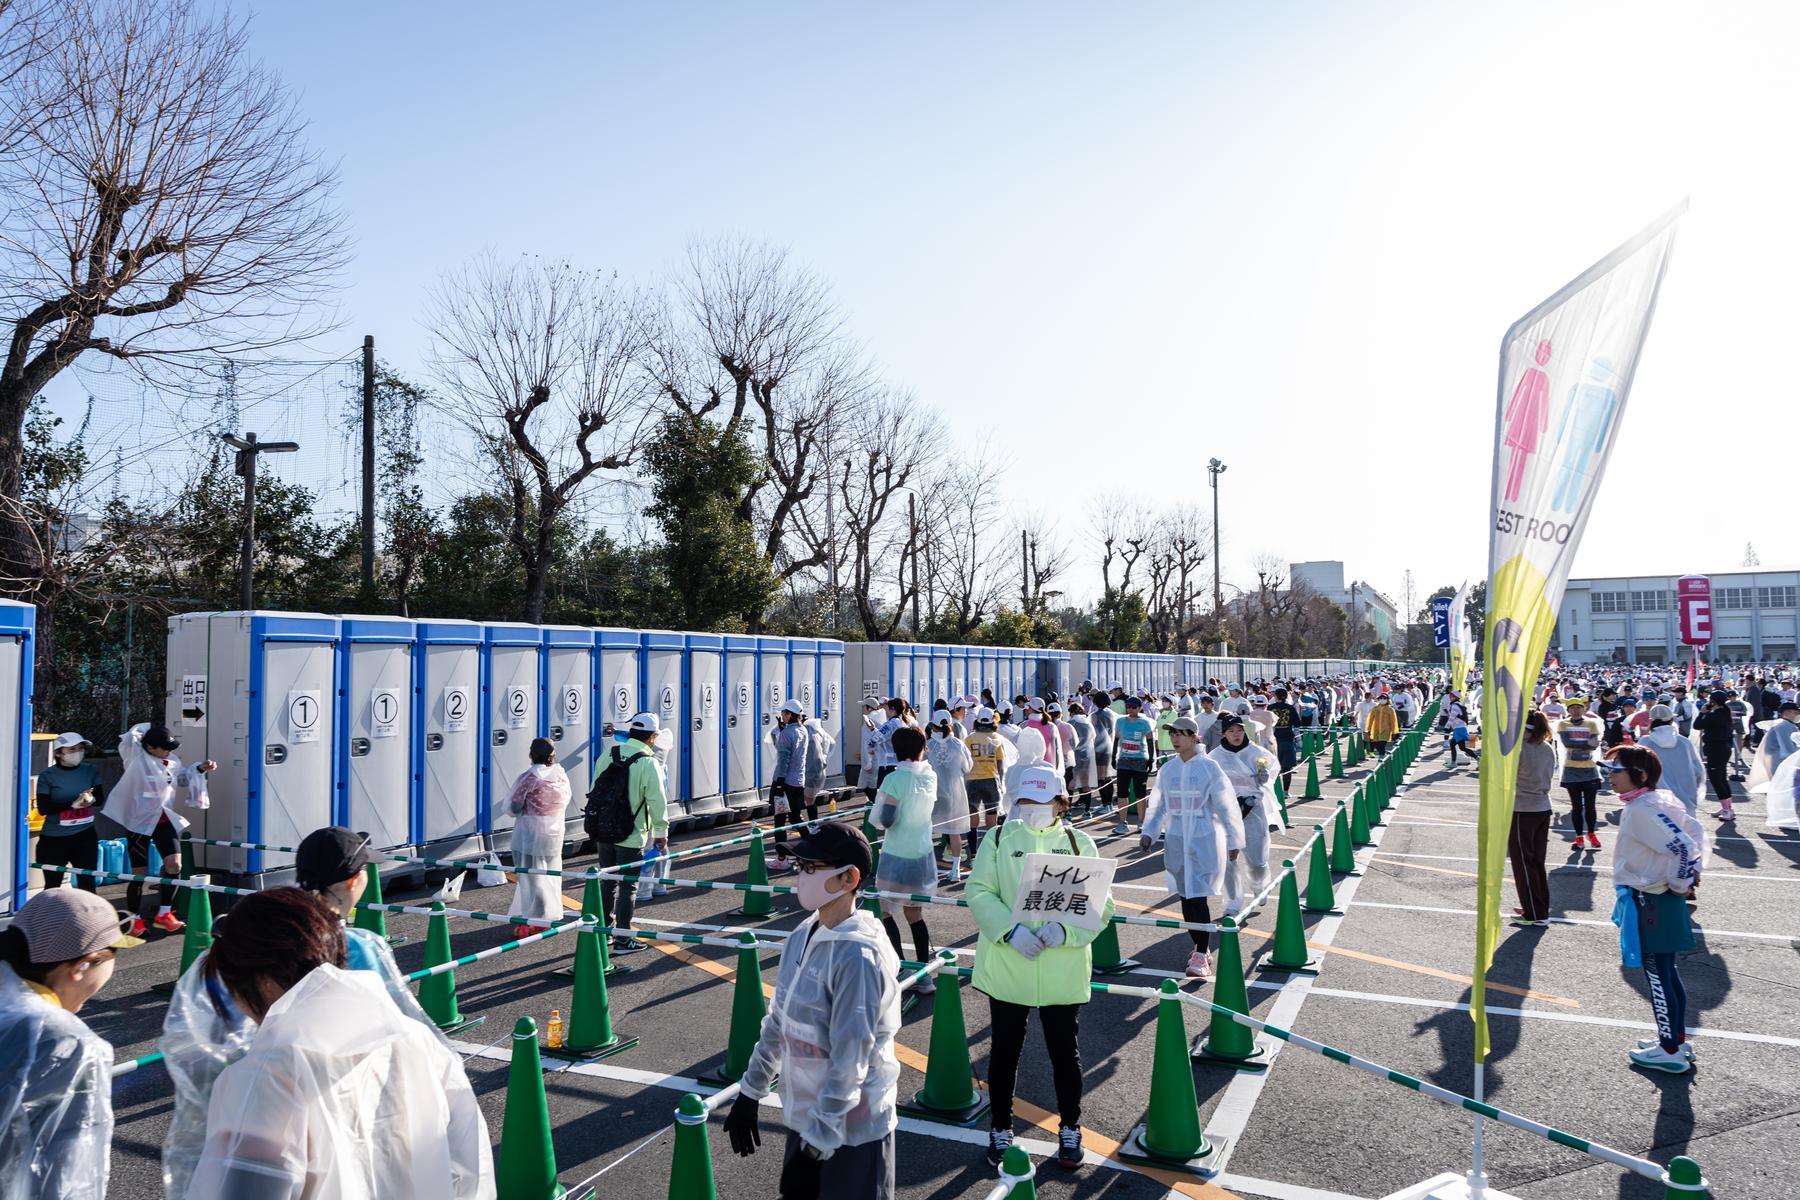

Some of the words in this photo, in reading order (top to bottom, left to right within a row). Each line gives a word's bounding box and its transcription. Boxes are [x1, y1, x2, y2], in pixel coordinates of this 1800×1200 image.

[1496, 508, 1524, 536] EST
[1525, 517, 1571, 545] ROO
[1434, 611, 1448, 647] トイレ
[1688, 600, 1711, 639] E
[183, 680, 206, 695] 出口
[1038, 864, 1090, 885] トイレ
[1022, 890, 1089, 916] 最後尾
[1646, 970, 1673, 1040] JAZZERCISE
